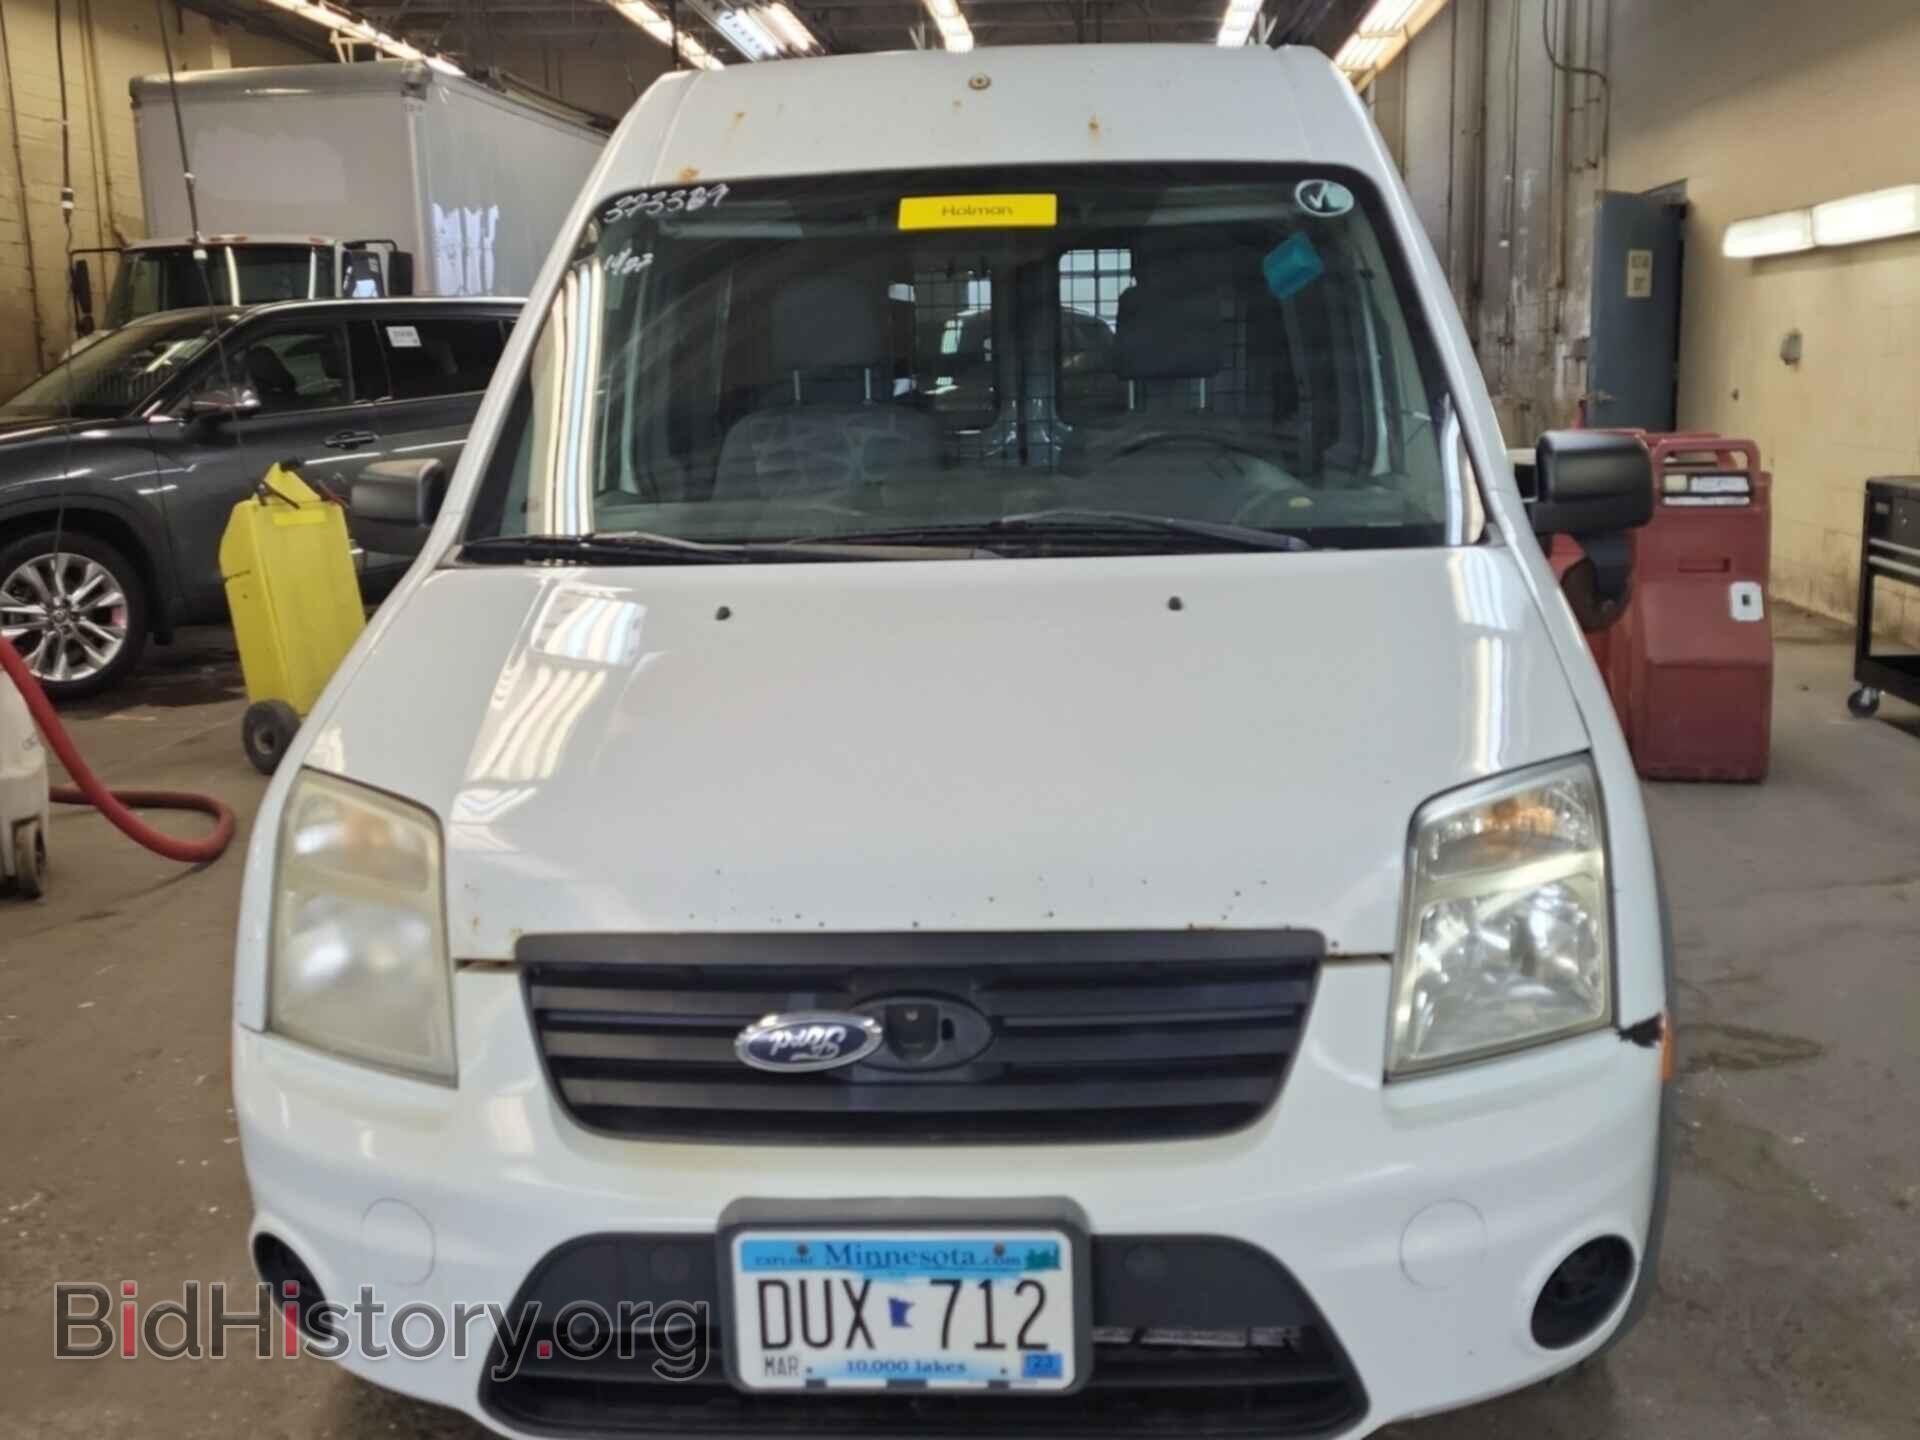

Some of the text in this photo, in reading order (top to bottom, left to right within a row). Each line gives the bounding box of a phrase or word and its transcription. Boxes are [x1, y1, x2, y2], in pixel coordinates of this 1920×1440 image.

[941, 203, 1014, 217] Holman
[768, 1025, 847, 1062] Ford
[756, 1278, 1049, 1351] DUX 712
[763, 1355, 800, 1377] MAR
[914, 1358, 967, 1373] lakes
